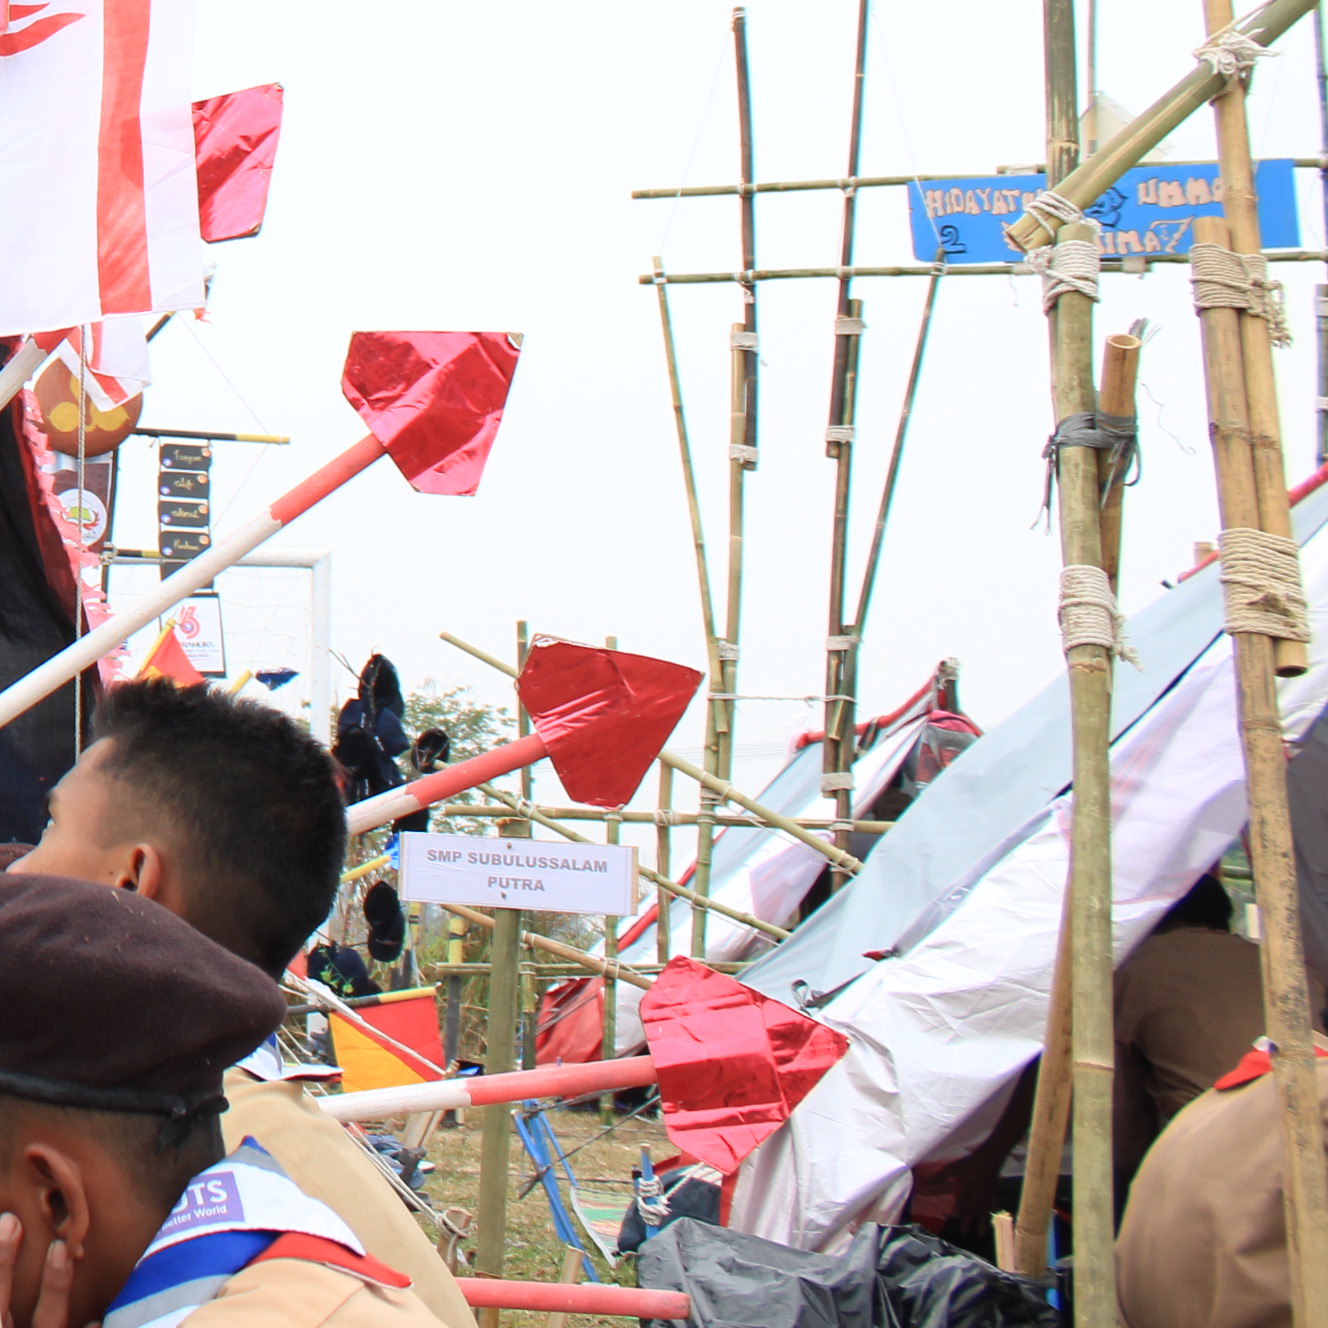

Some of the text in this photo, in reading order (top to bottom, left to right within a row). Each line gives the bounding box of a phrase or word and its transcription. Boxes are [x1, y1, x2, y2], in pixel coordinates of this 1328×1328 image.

[427, 848, 608, 873] SMP SUBULUSSALAM
[487, 876, 545, 892] PUTRA
[193, 1204, 228, 1219] World
